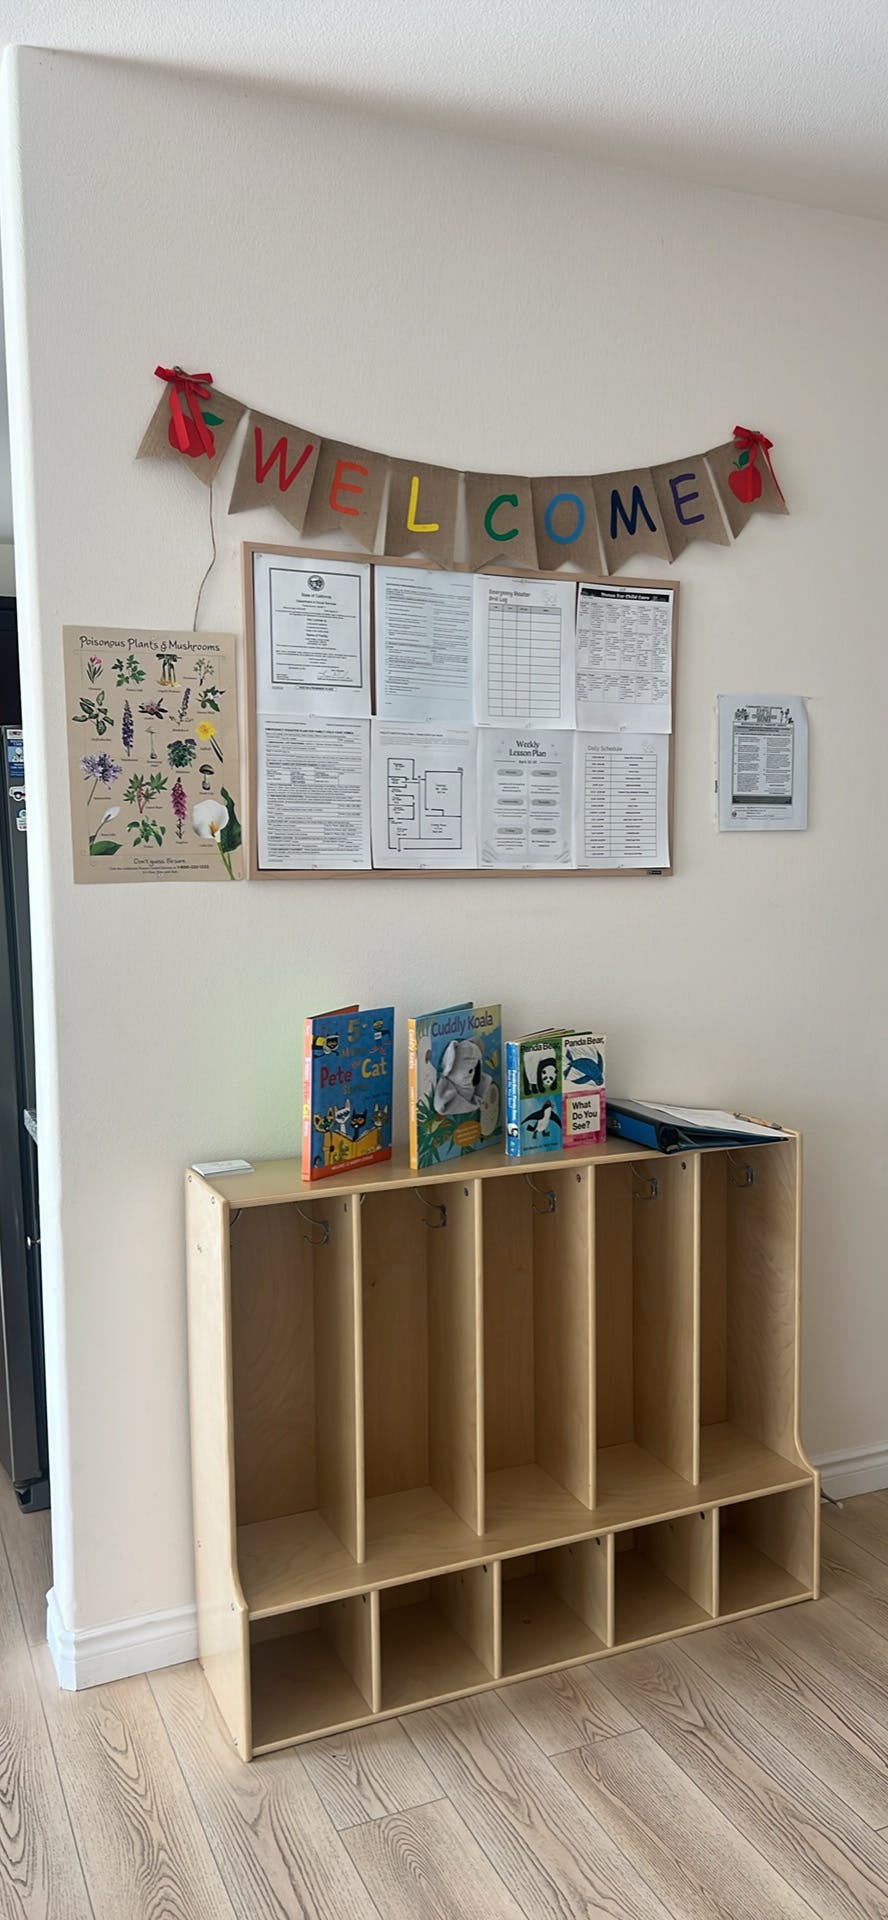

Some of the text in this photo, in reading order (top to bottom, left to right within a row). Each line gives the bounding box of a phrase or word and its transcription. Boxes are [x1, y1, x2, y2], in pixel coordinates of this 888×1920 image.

[254, 426, 705, 545] WELCOME
[79, 635, 126, 649] Poisonous
[127, 637, 159, 651] Plants
[168, 640, 221, 652] Mushrooms
[516, 739, 540, 749] Weekly
[509, 749, 532, 757] Lesson
[431, 1010, 494, 1037] Cuddly Koala
[564, 1036, 605, 1048] Panda Bear,
[361, 1057, 388, 1079] Cat
[320, 1065, 353, 1089] Pete
[572, 1100, 591, 1111] What
[572, 1110, 598, 1120] Do You
[572, 1120, 591, 1131] See?
